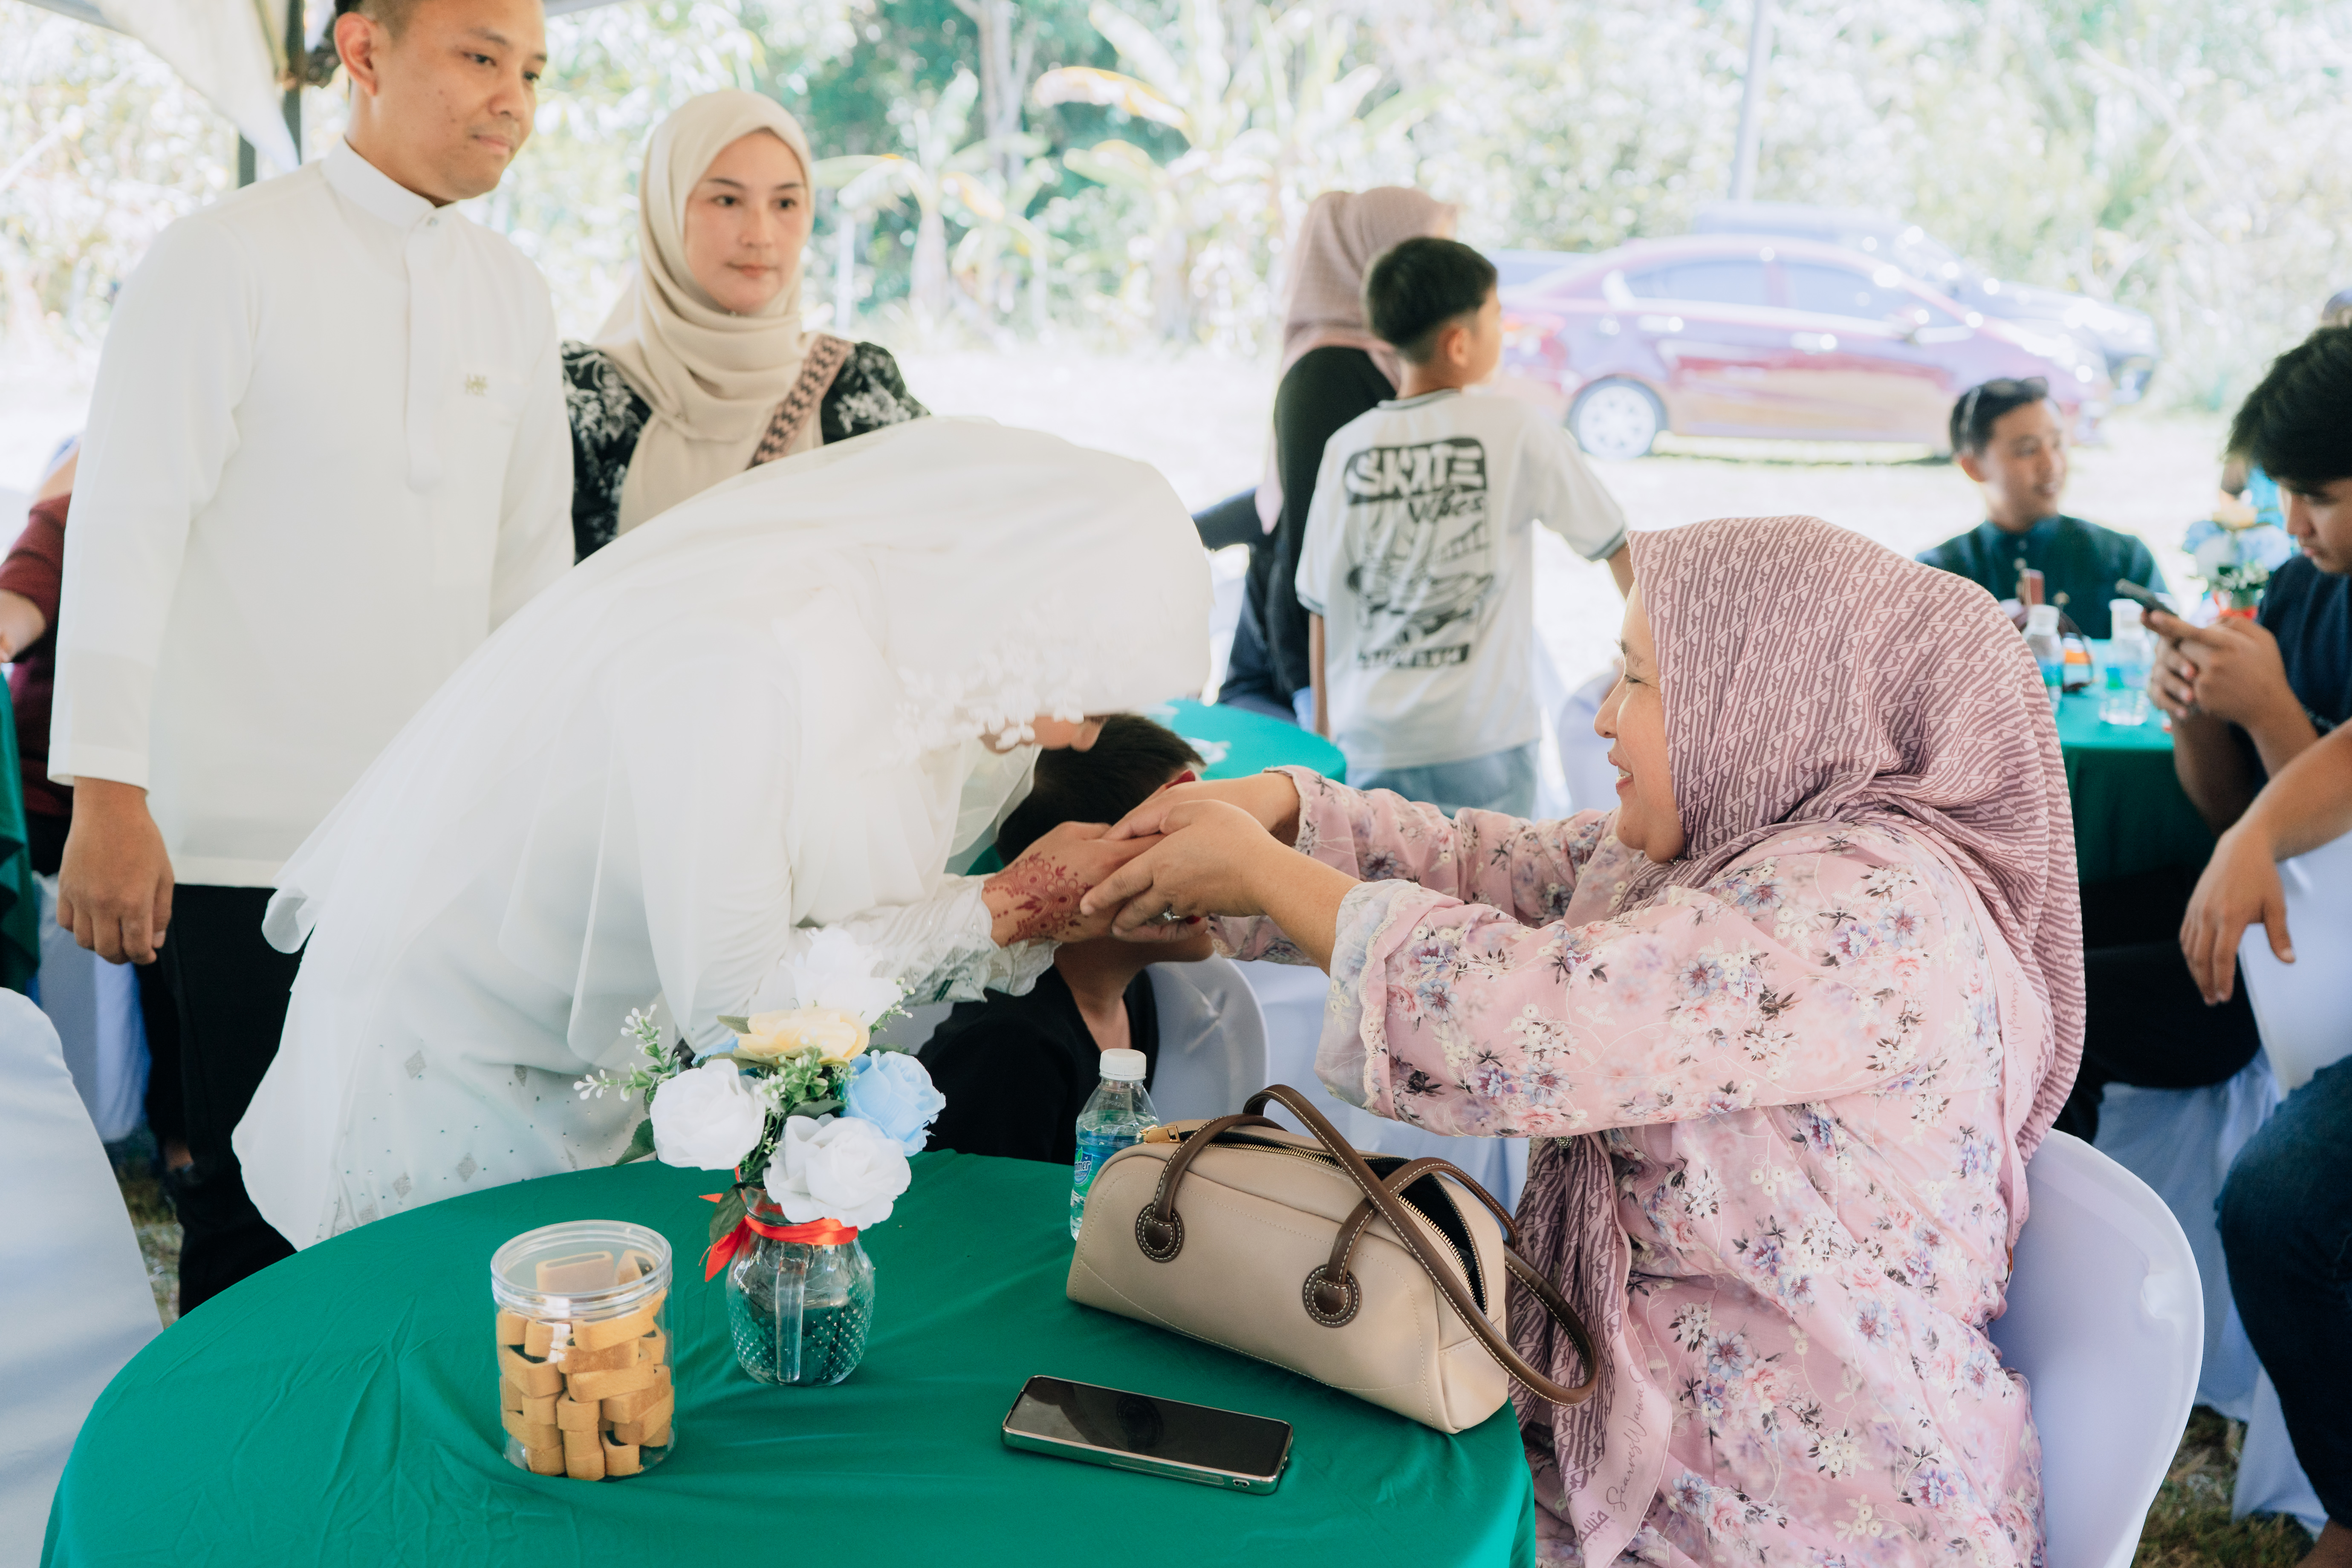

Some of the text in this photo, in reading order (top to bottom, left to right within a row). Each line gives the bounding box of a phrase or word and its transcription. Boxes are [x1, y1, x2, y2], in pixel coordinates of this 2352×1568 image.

[1345, 441, 1484, 498] SKATE
[1075, 1161, 1090, 1170] mmer
[1582, 1519, 1616, 1556] CARVES
